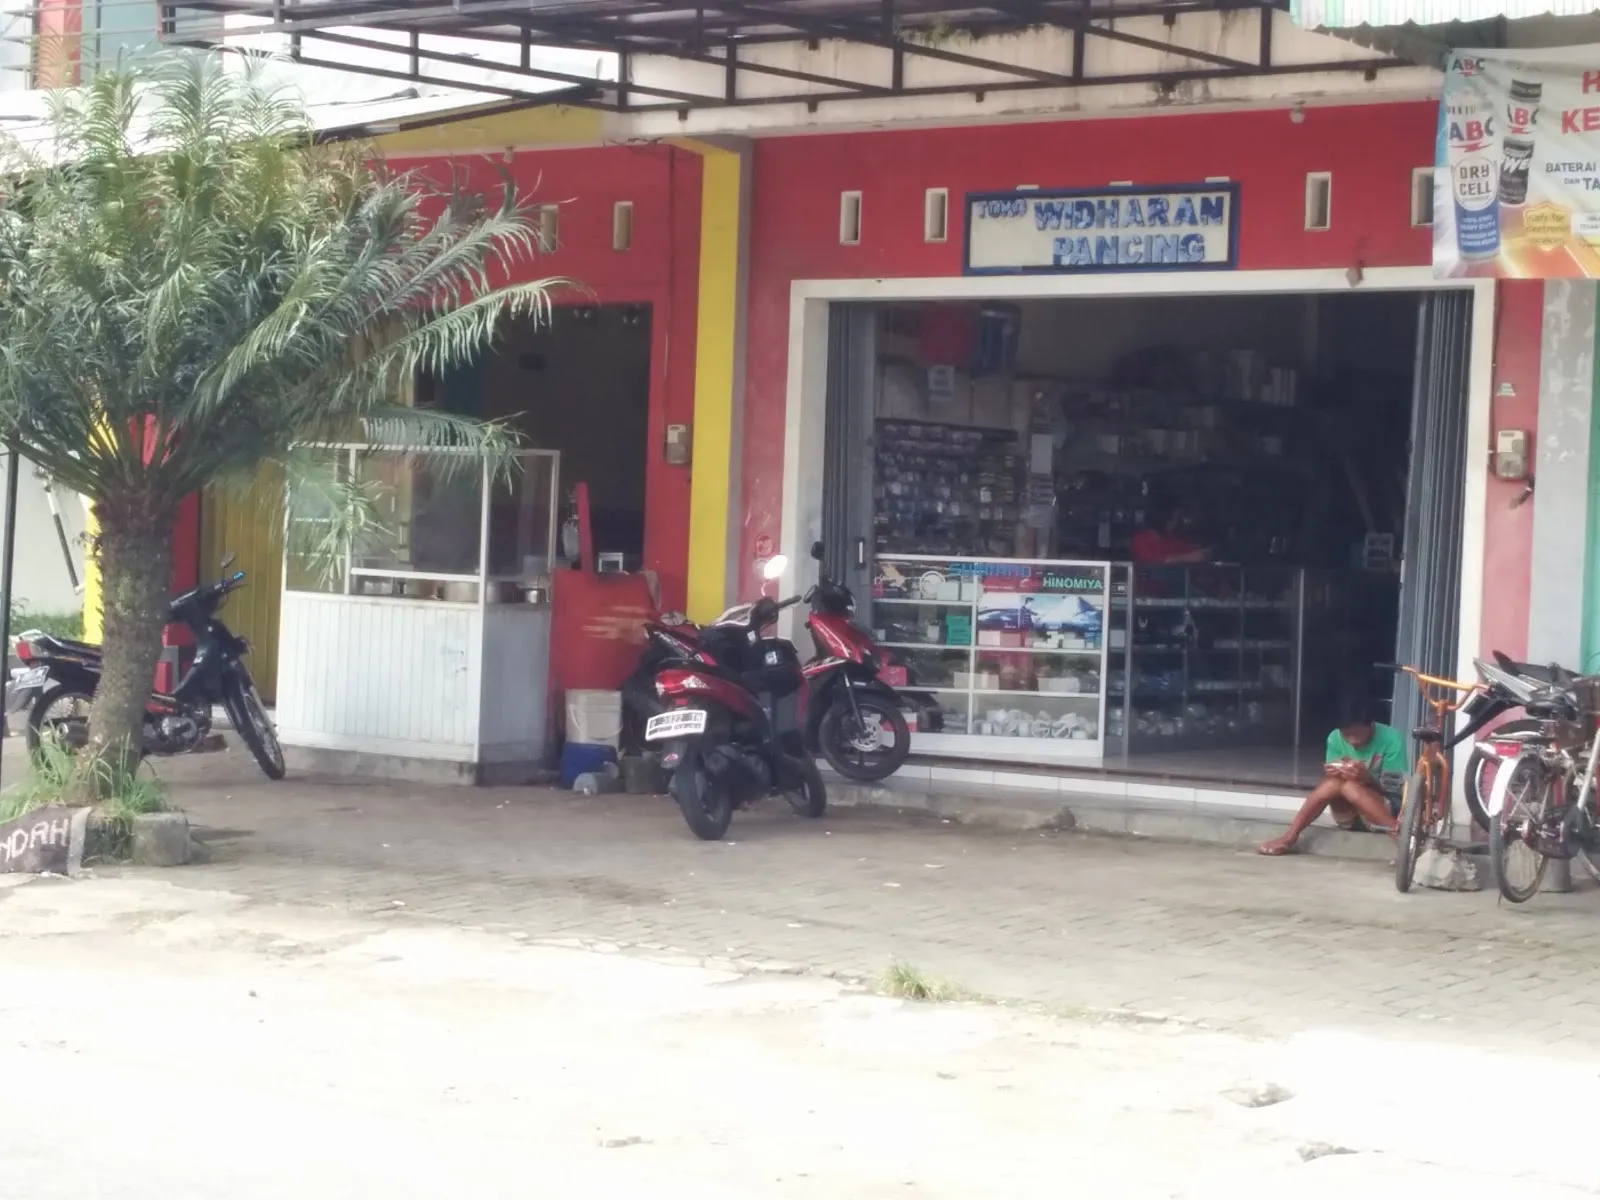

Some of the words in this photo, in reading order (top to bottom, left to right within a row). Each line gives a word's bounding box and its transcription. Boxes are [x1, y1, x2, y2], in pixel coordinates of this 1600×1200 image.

[1452, 58, 1486, 71] ABC
[1450, 117, 1495, 142] ABC
[1459, 164, 1490, 180] DRY
[1545, 162, 1597, 174] BATERAI
[1459, 183, 1492, 197] CELL
[1033, 195, 1225, 231] WIDHARAN
[1052, 233, 1205, 266] PANCING
[1043, 577, 1103, 590] HINOMIYA
